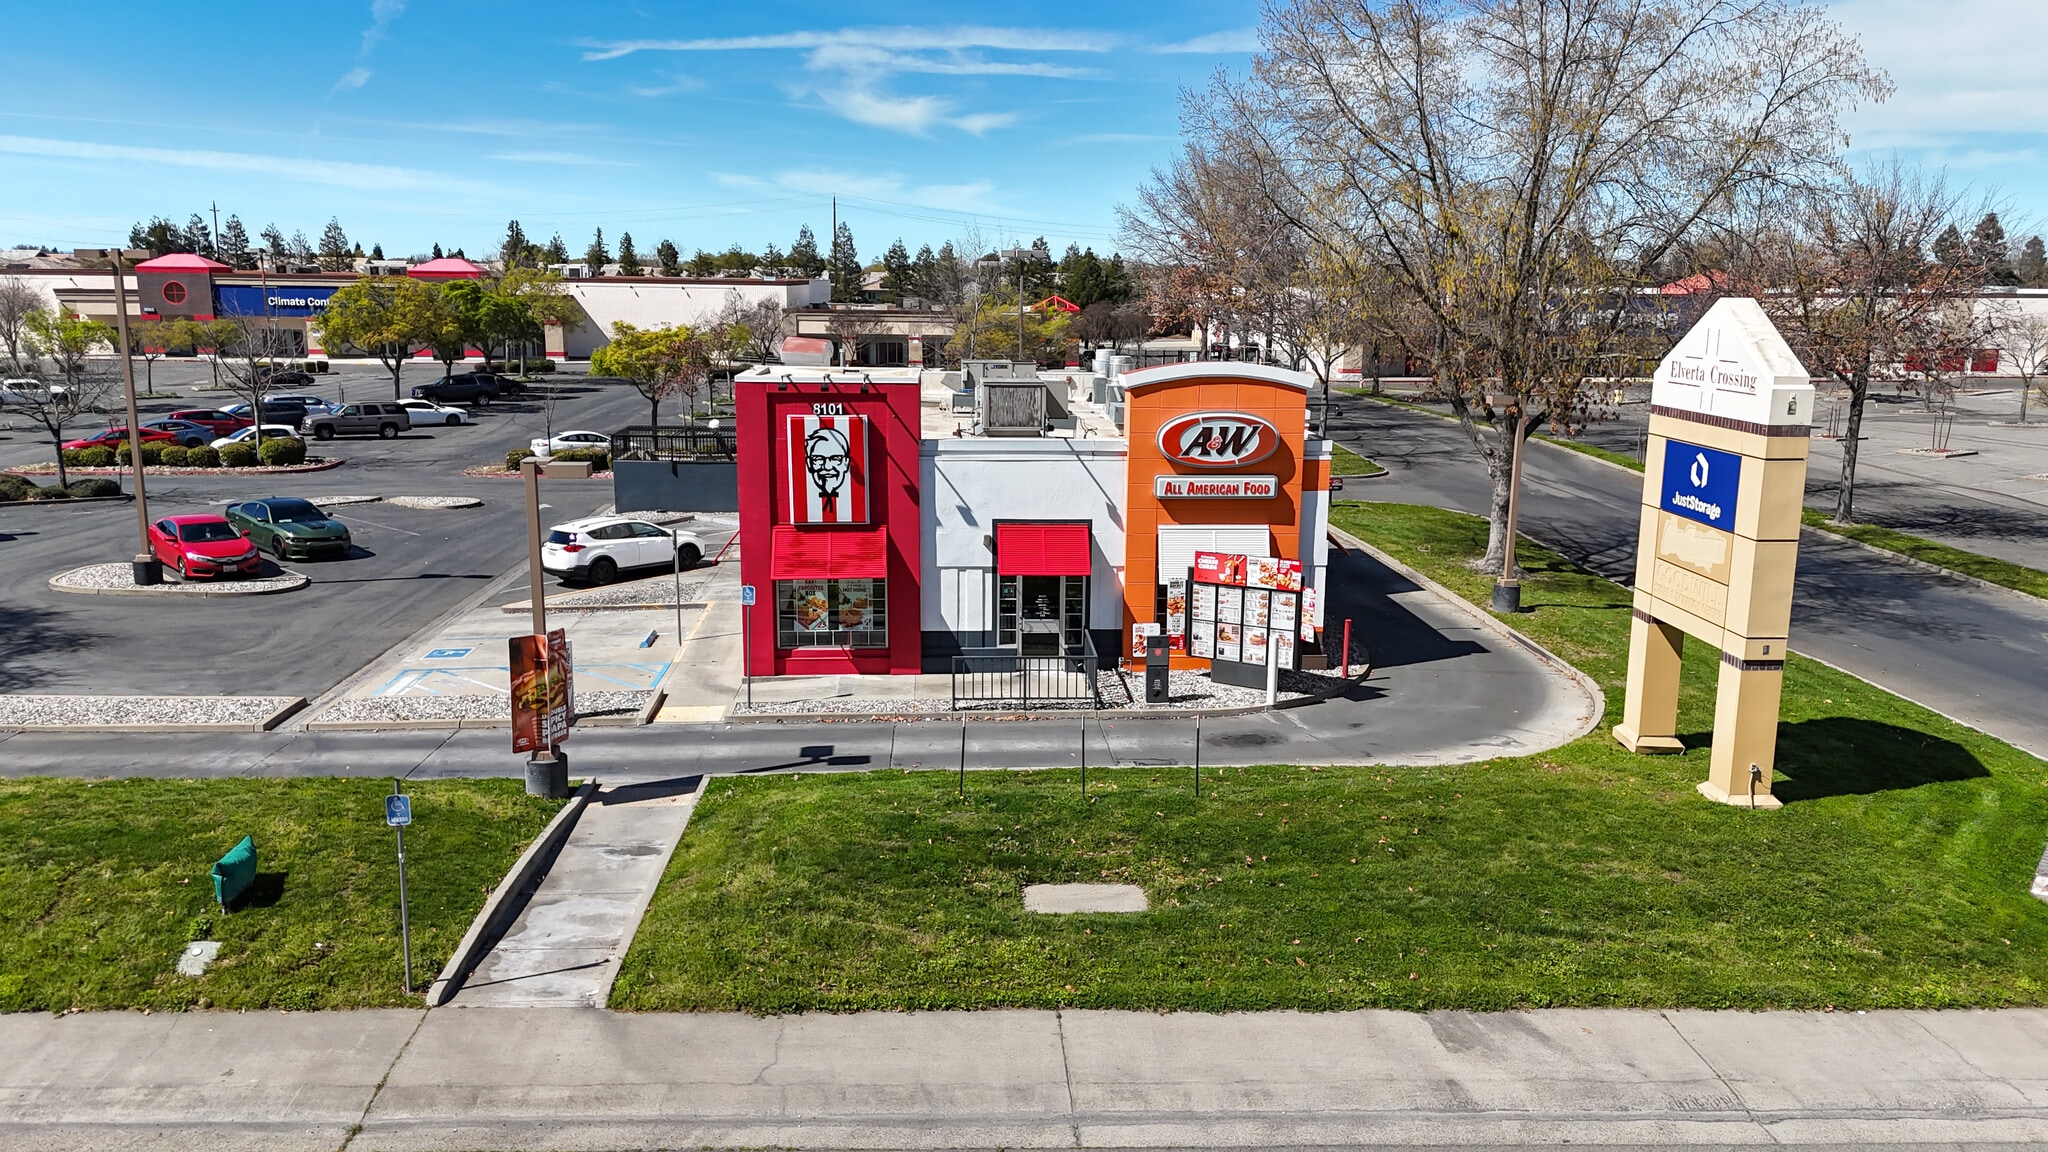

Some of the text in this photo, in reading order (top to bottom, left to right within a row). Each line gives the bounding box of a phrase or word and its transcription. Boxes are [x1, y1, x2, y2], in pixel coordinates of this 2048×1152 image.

[268, 296, 306, 306] Climate
[1670, 360, 1758, 392] Elverta Crossing
[813, 402, 843, 415] 8101
[1180, 425, 1261, 457] A&W
[1672, 491, 1721, 520] JustStorage
